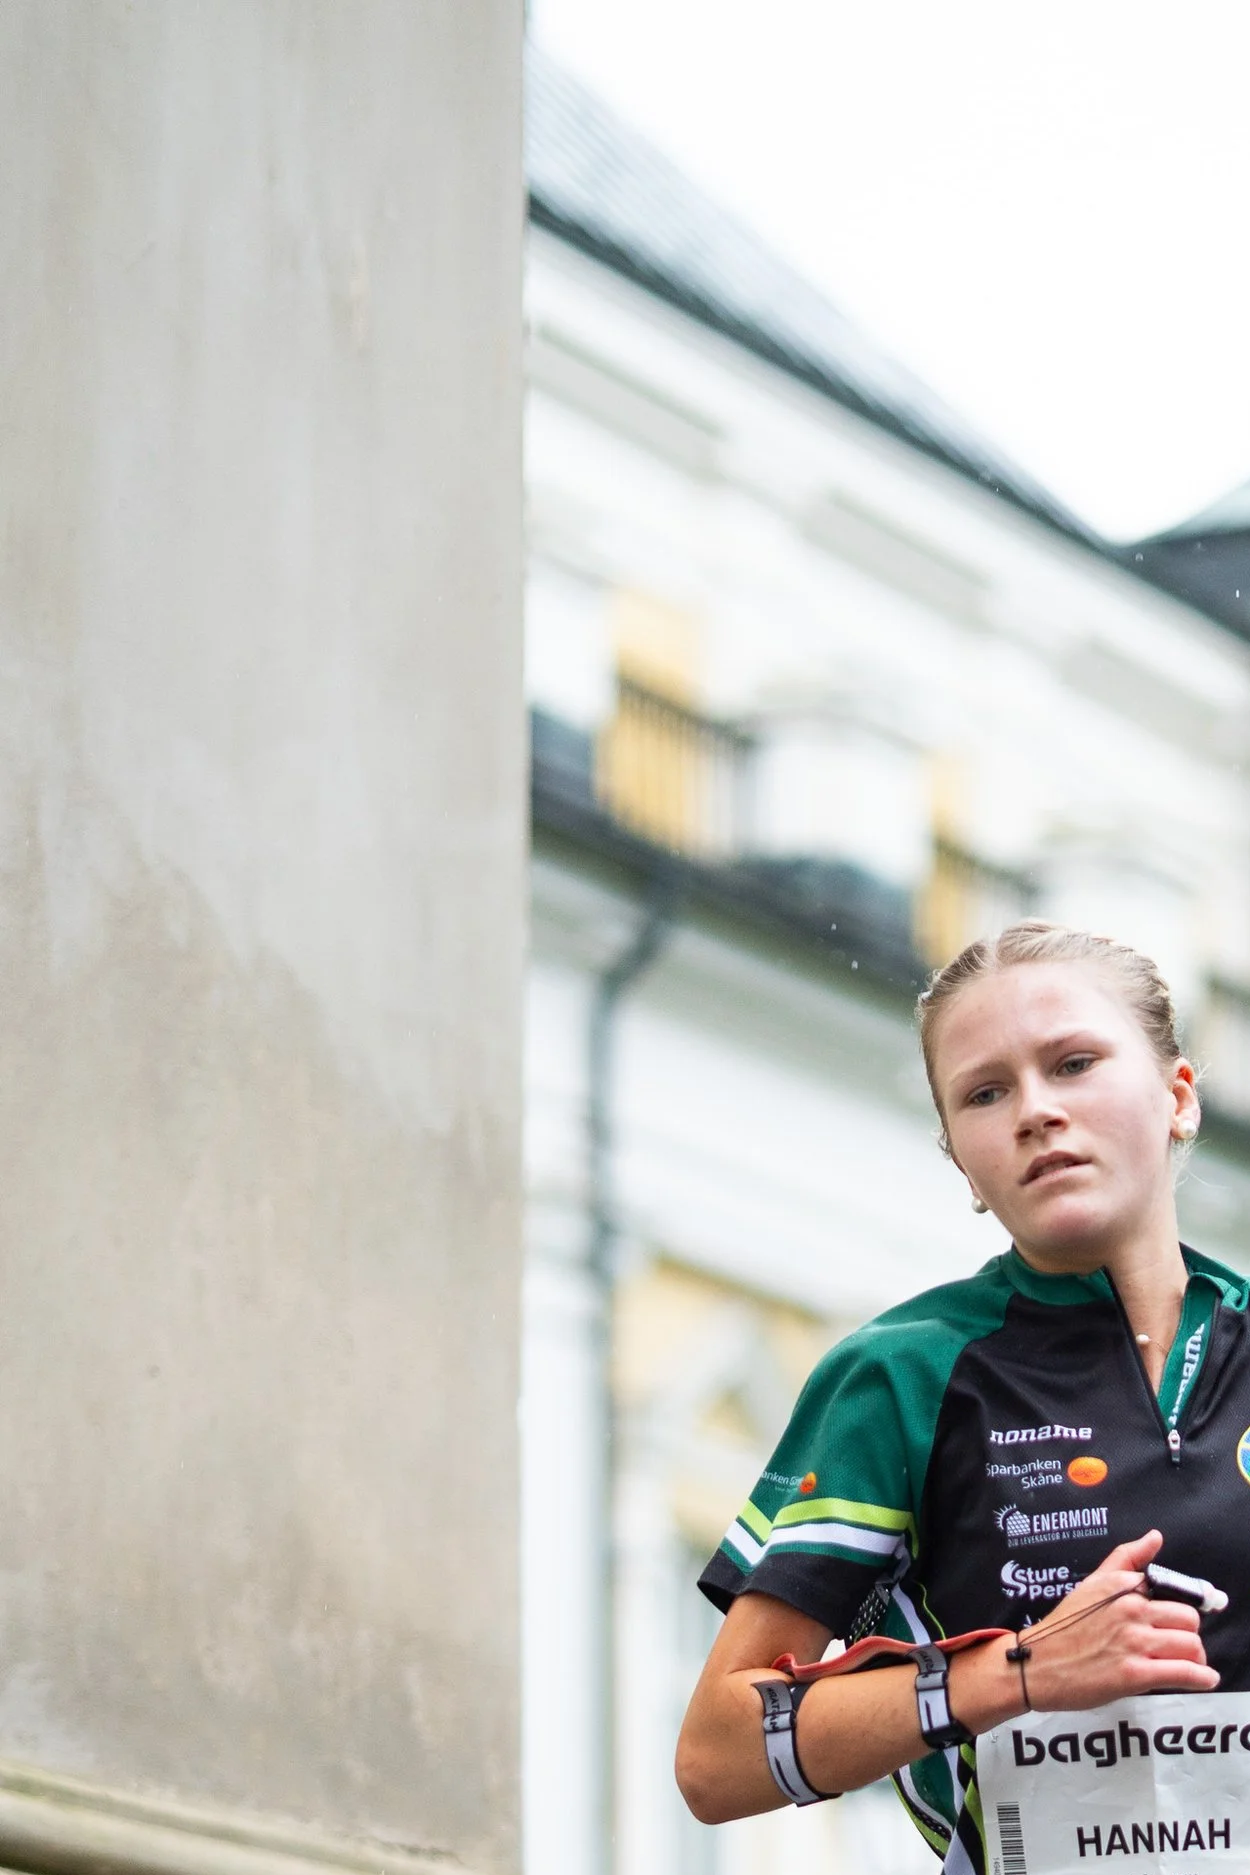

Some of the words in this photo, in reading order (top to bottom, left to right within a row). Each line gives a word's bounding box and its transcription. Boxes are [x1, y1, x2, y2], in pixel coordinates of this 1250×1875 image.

[990, 1424, 1092, 1444] noname
[985, 1458, 1062, 1477] Sparbanken
[1021, 1473, 1063, 1489] Skåne
[1033, 1507, 1108, 1533] ENERMONT
[1029, 1580, 1077, 1599] pers
[1076, 1818, 1231, 1857] HANNAH
